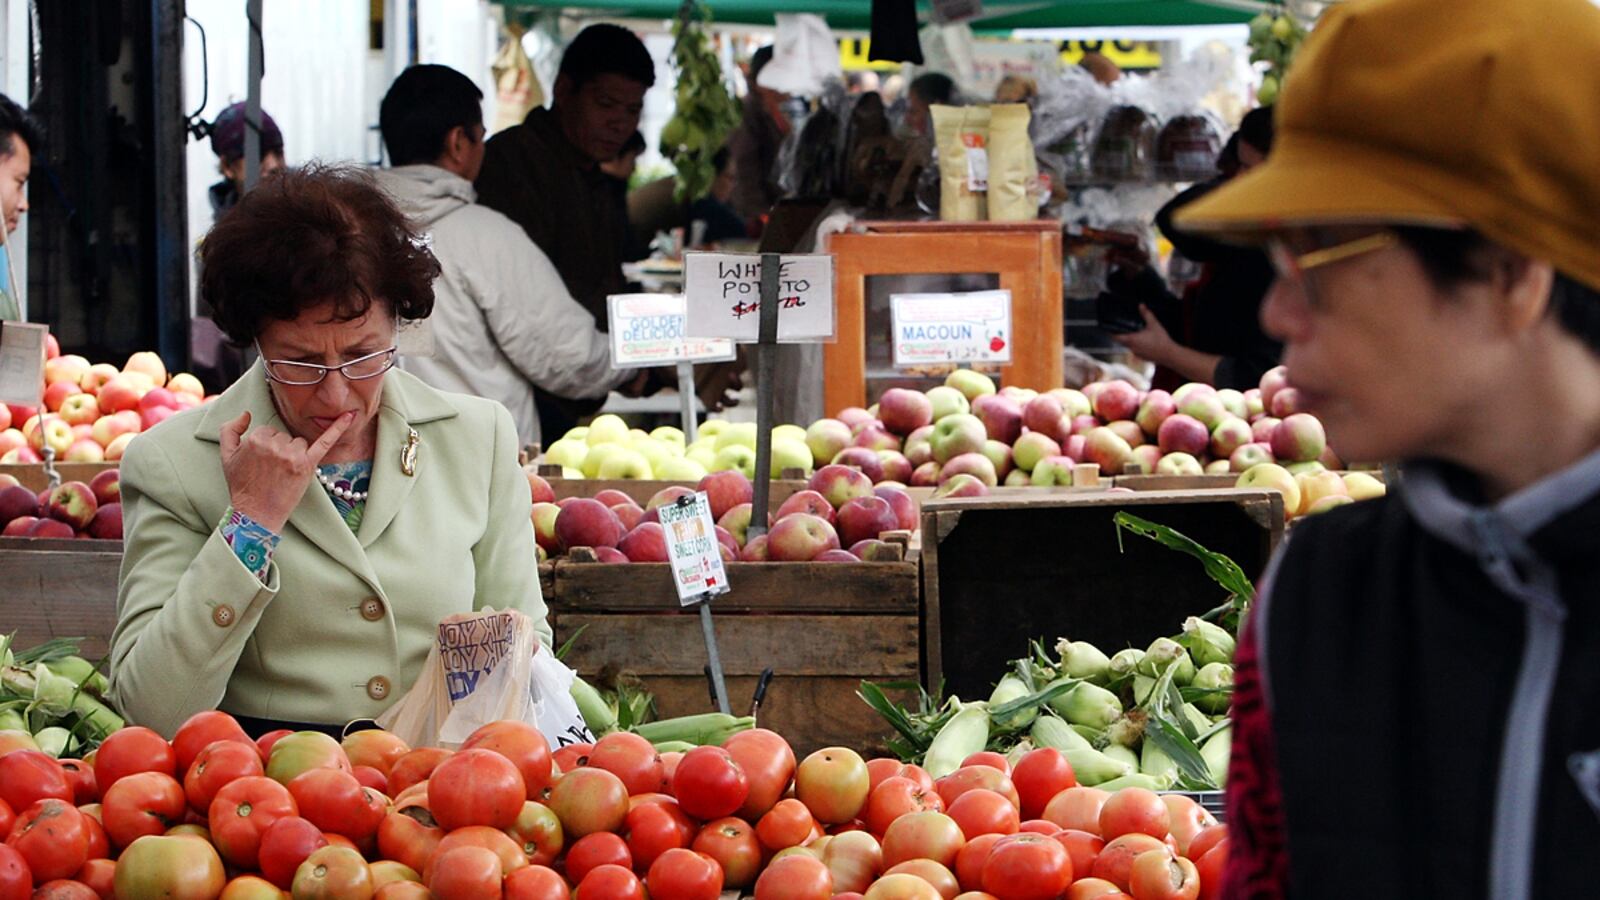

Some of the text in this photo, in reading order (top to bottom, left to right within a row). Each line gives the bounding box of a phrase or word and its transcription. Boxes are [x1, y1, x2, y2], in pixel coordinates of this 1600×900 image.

[719, 261, 797, 279] WHE
[723, 279, 810, 299] POTTO
[623, 326, 686, 341] DELICIOU
[902, 325, 972, 340] MACOUN
[674, 540, 697, 559] SWEET
